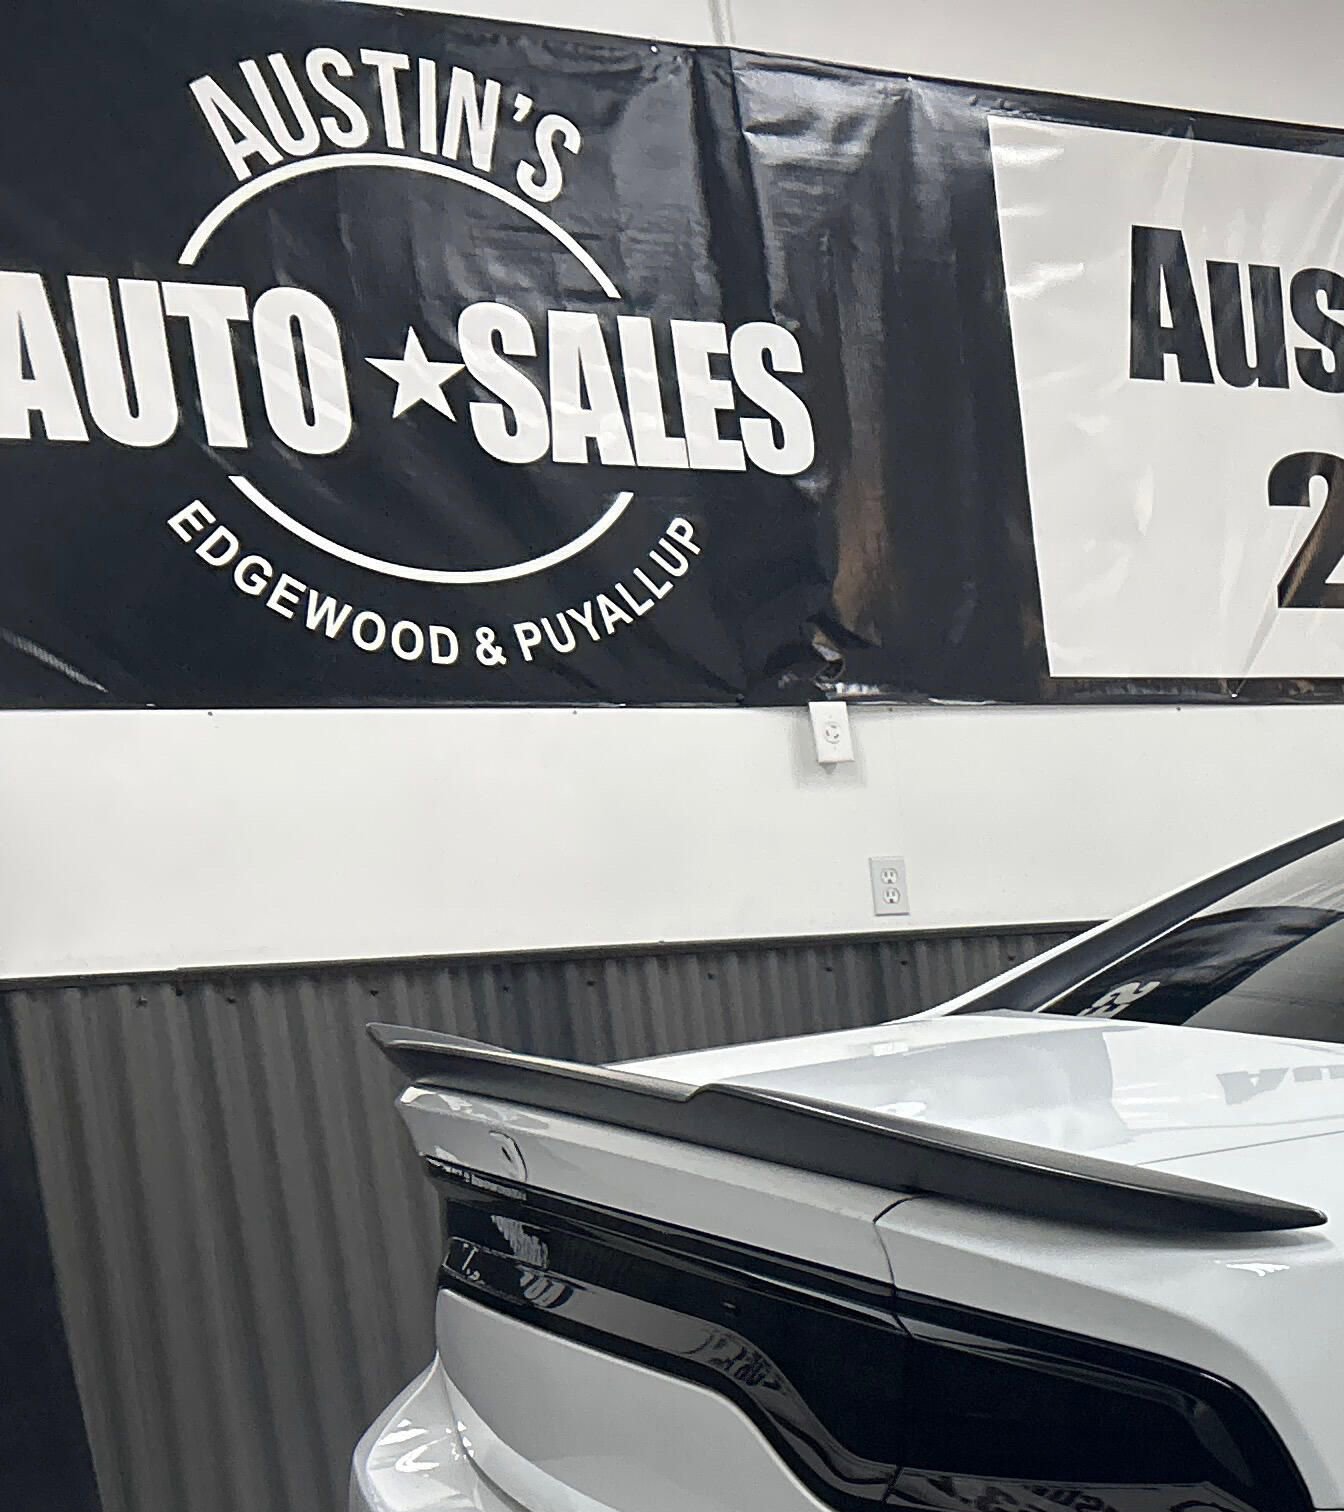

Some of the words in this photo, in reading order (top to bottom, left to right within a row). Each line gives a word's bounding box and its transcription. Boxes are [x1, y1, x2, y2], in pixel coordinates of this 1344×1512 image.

[190, 47, 581, 203] AUSTIN'S
[0, 270, 353, 455] AUTO
[457, 301, 815, 475] SALES
[167, 499, 459, 665] EDGEWOOD
[475, 626, 507, 666] &
[513, 517, 701, 662] PUYALLUP
